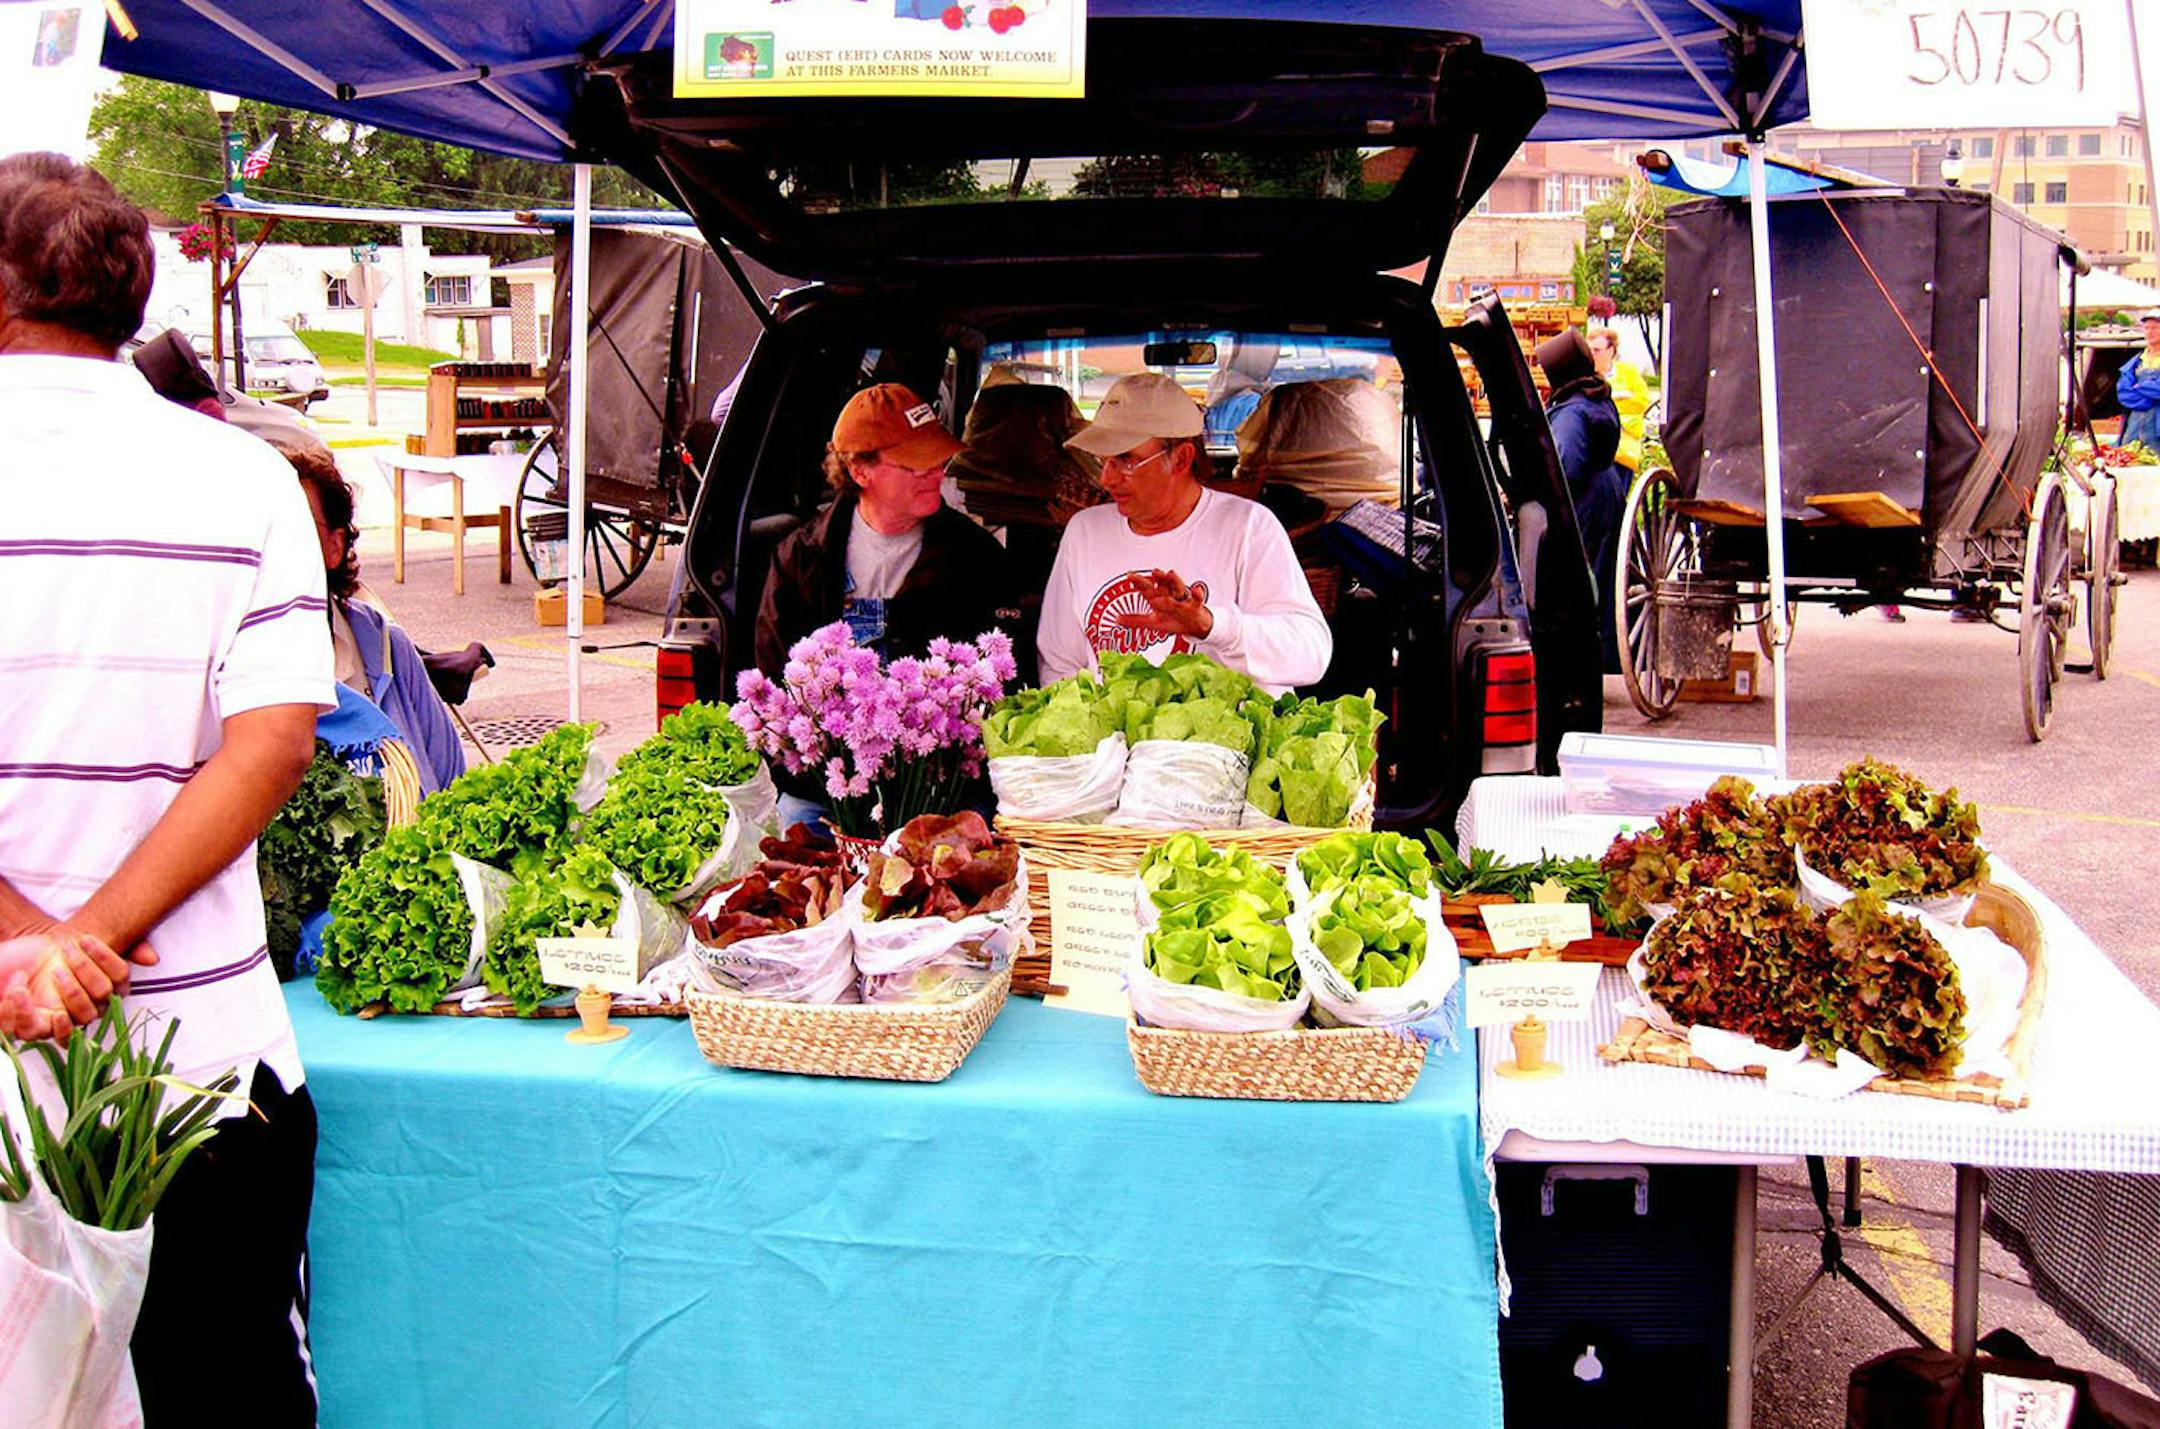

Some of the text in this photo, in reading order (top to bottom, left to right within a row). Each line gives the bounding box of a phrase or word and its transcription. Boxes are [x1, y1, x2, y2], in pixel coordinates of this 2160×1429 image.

[785, 50, 1057, 62] QUEST (EBT) CARDS NOW WELCOME
[1908, 9, 2083, 92] 50739
[786, 65, 804, 76] AT
[810, 65, 843, 76] THIS
[848, 65, 919, 76] FARMERS
